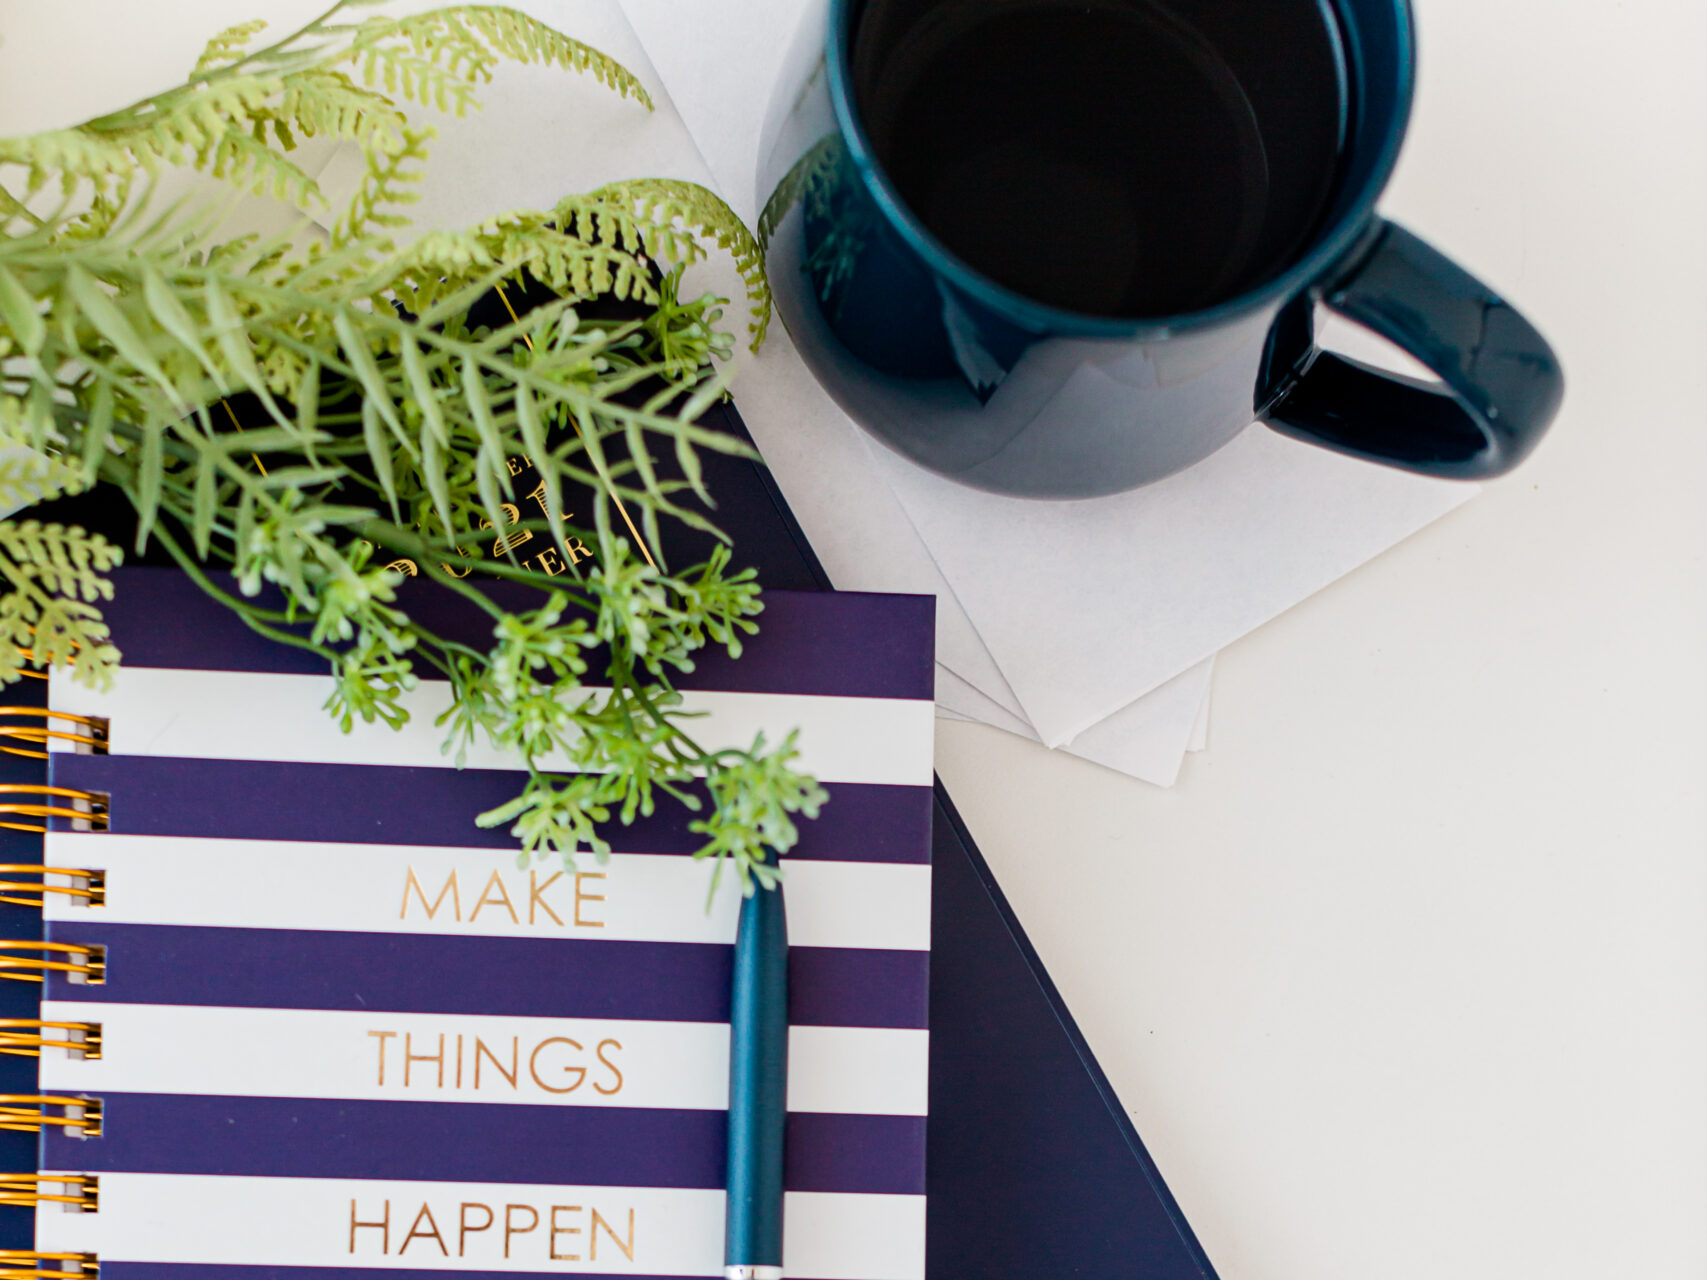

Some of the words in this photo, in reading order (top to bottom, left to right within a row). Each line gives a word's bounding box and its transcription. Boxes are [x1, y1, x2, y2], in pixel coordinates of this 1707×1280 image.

[399, 865, 608, 929] MAKE
[367, 1030, 624, 1097] THINGS
[348, 1197, 635, 1263] HAPPEN
